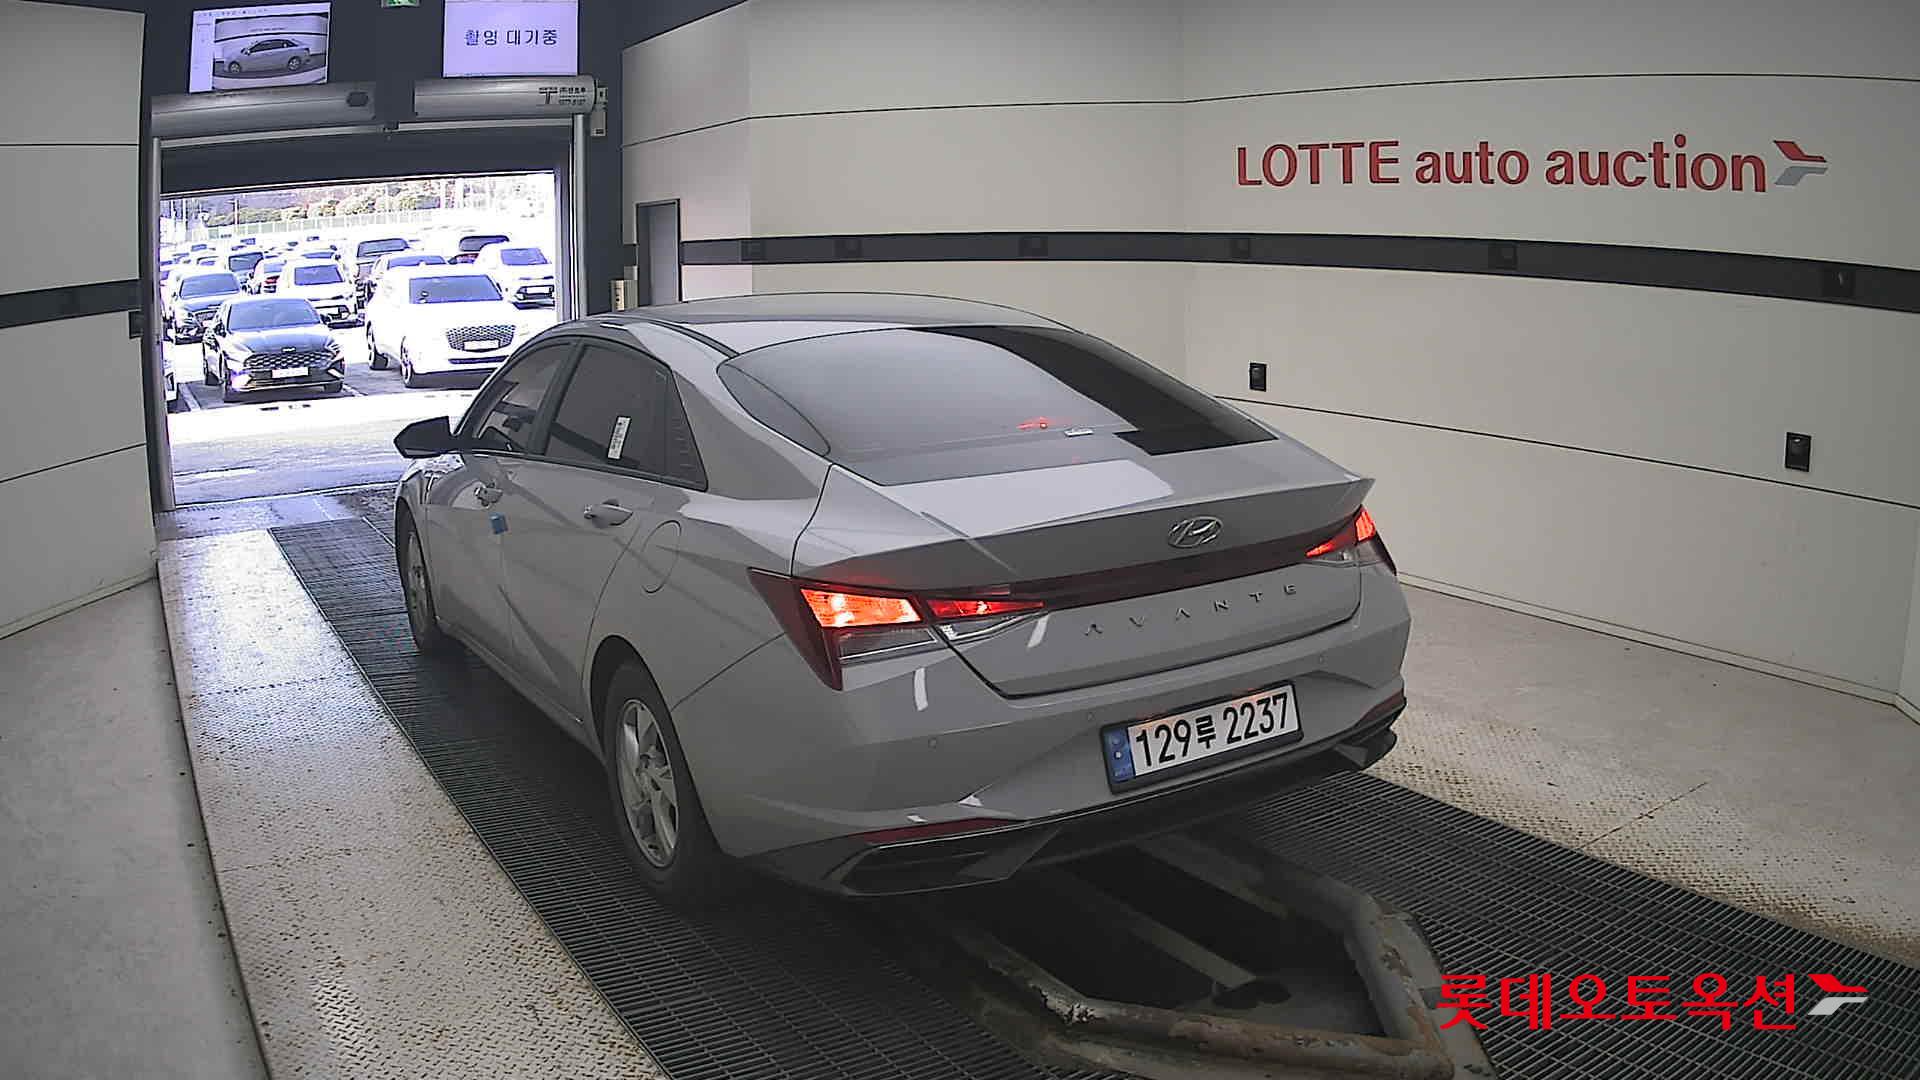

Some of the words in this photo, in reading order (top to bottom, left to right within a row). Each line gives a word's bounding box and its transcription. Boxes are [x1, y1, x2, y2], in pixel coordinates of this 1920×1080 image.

[506, 29, 559, 47] 대기중
[1237, 141, 1399, 187] LOTTE
[1415, 143, 1530, 185] auto
[1545, 134, 1767, 193] auction
[1083, 582, 1299, 637] AVANTE
[1134, 713, 1218, 768] 129루
[1222, 692, 1289, 745] 2237
